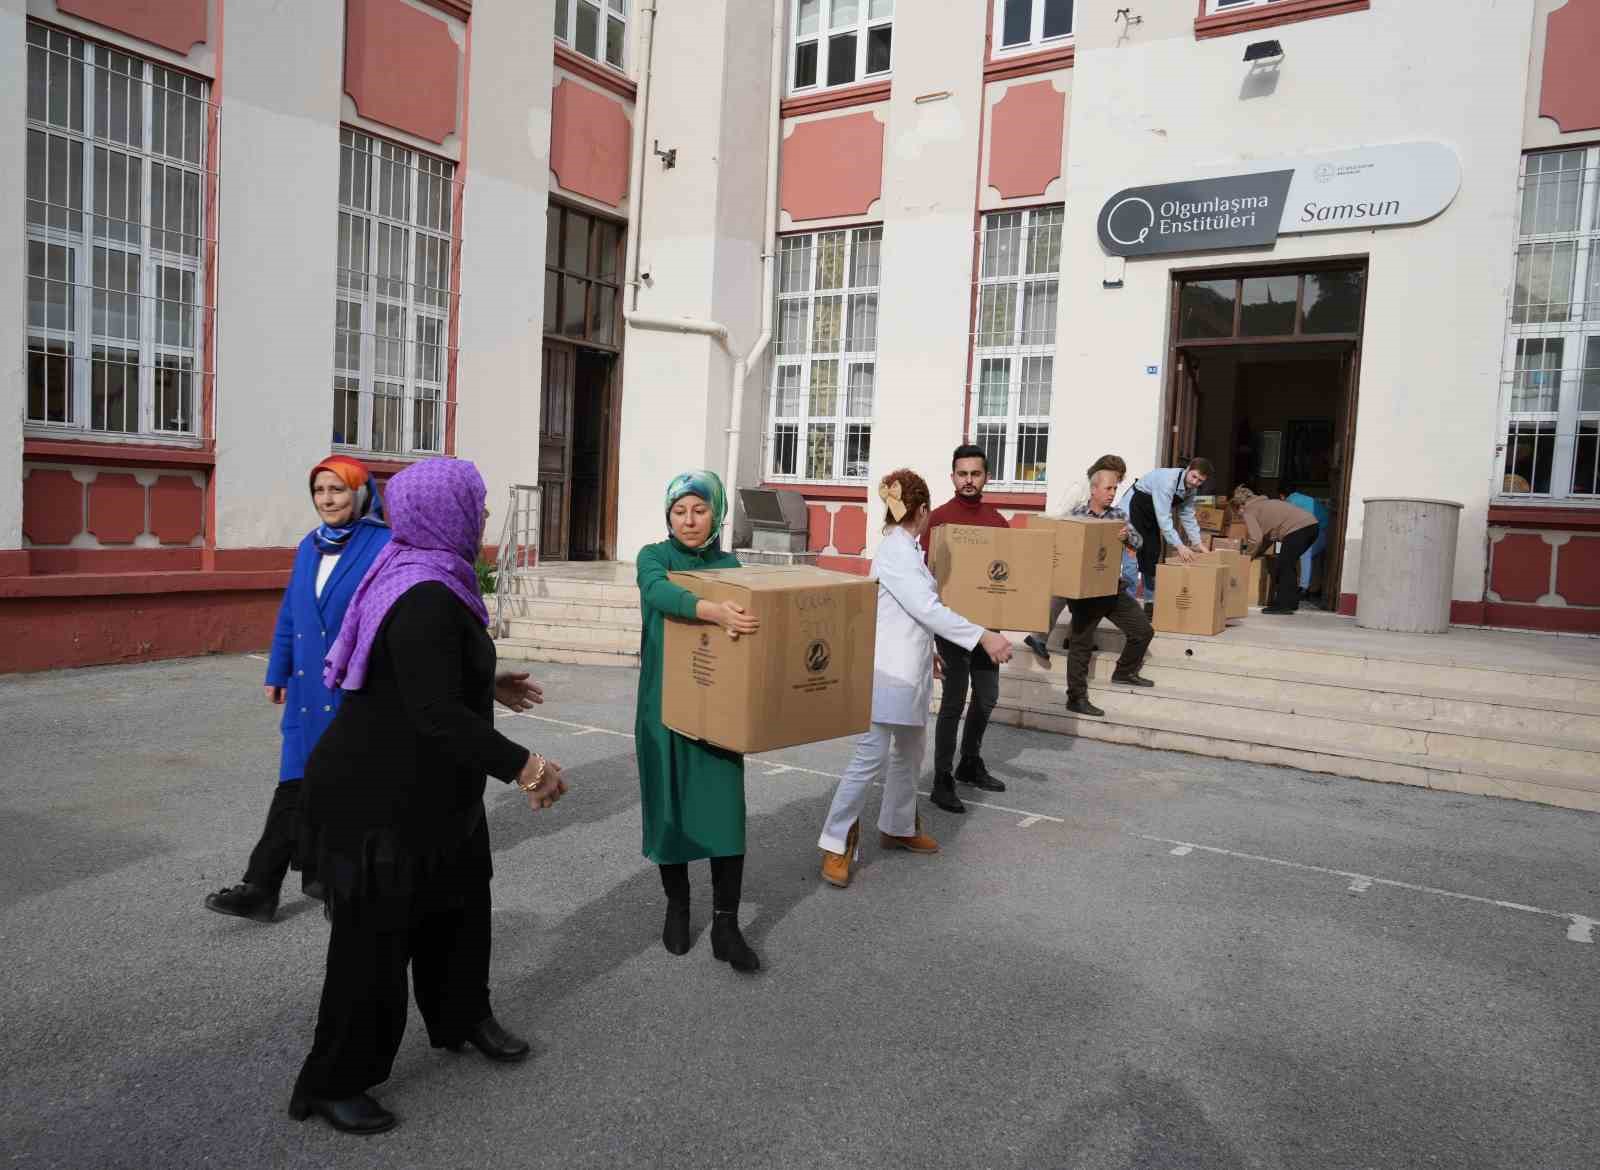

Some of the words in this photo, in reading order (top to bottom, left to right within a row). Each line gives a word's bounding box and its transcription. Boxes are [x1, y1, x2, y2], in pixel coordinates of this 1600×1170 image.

[1160, 196, 1269, 219] Olgunlaşma
[1300, 200, 1400, 222] Samsun
[1160, 211, 1256, 234] Enstitüleri
